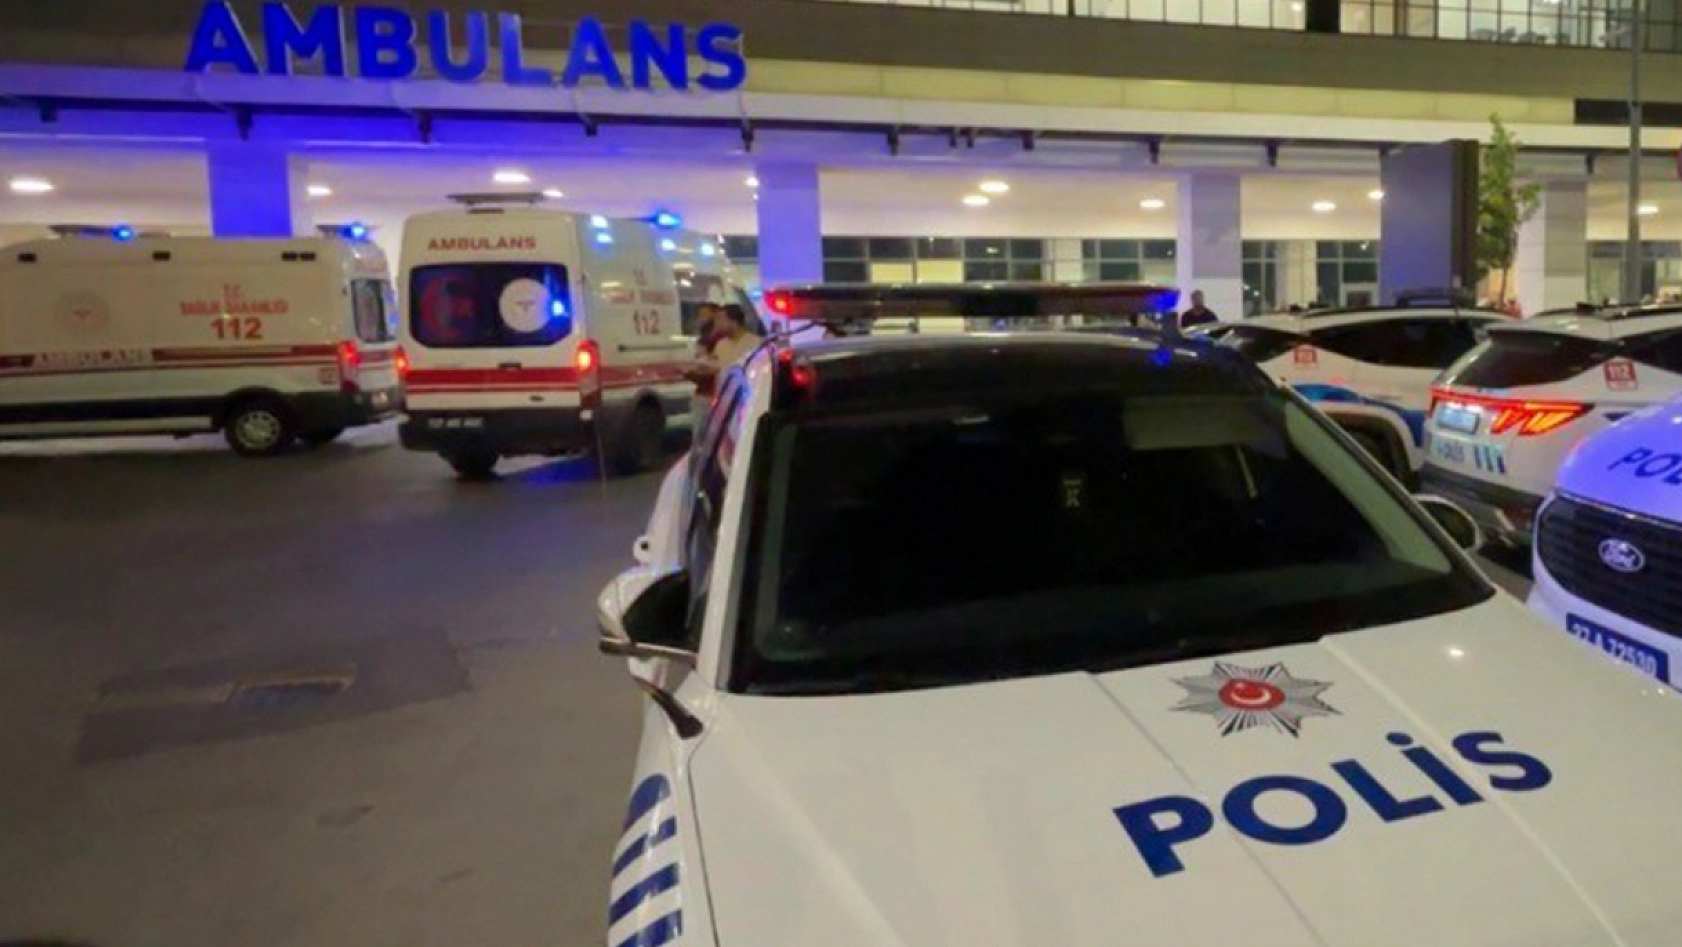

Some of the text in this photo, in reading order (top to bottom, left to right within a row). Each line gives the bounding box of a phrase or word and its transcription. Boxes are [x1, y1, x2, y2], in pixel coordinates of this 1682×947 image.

[183, 1, 748, 91] AMBULANS
[427, 235, 536, 250] AMBULANS
[210, 317, 263, 340] 112
[632, 309, 661, 335] 112
